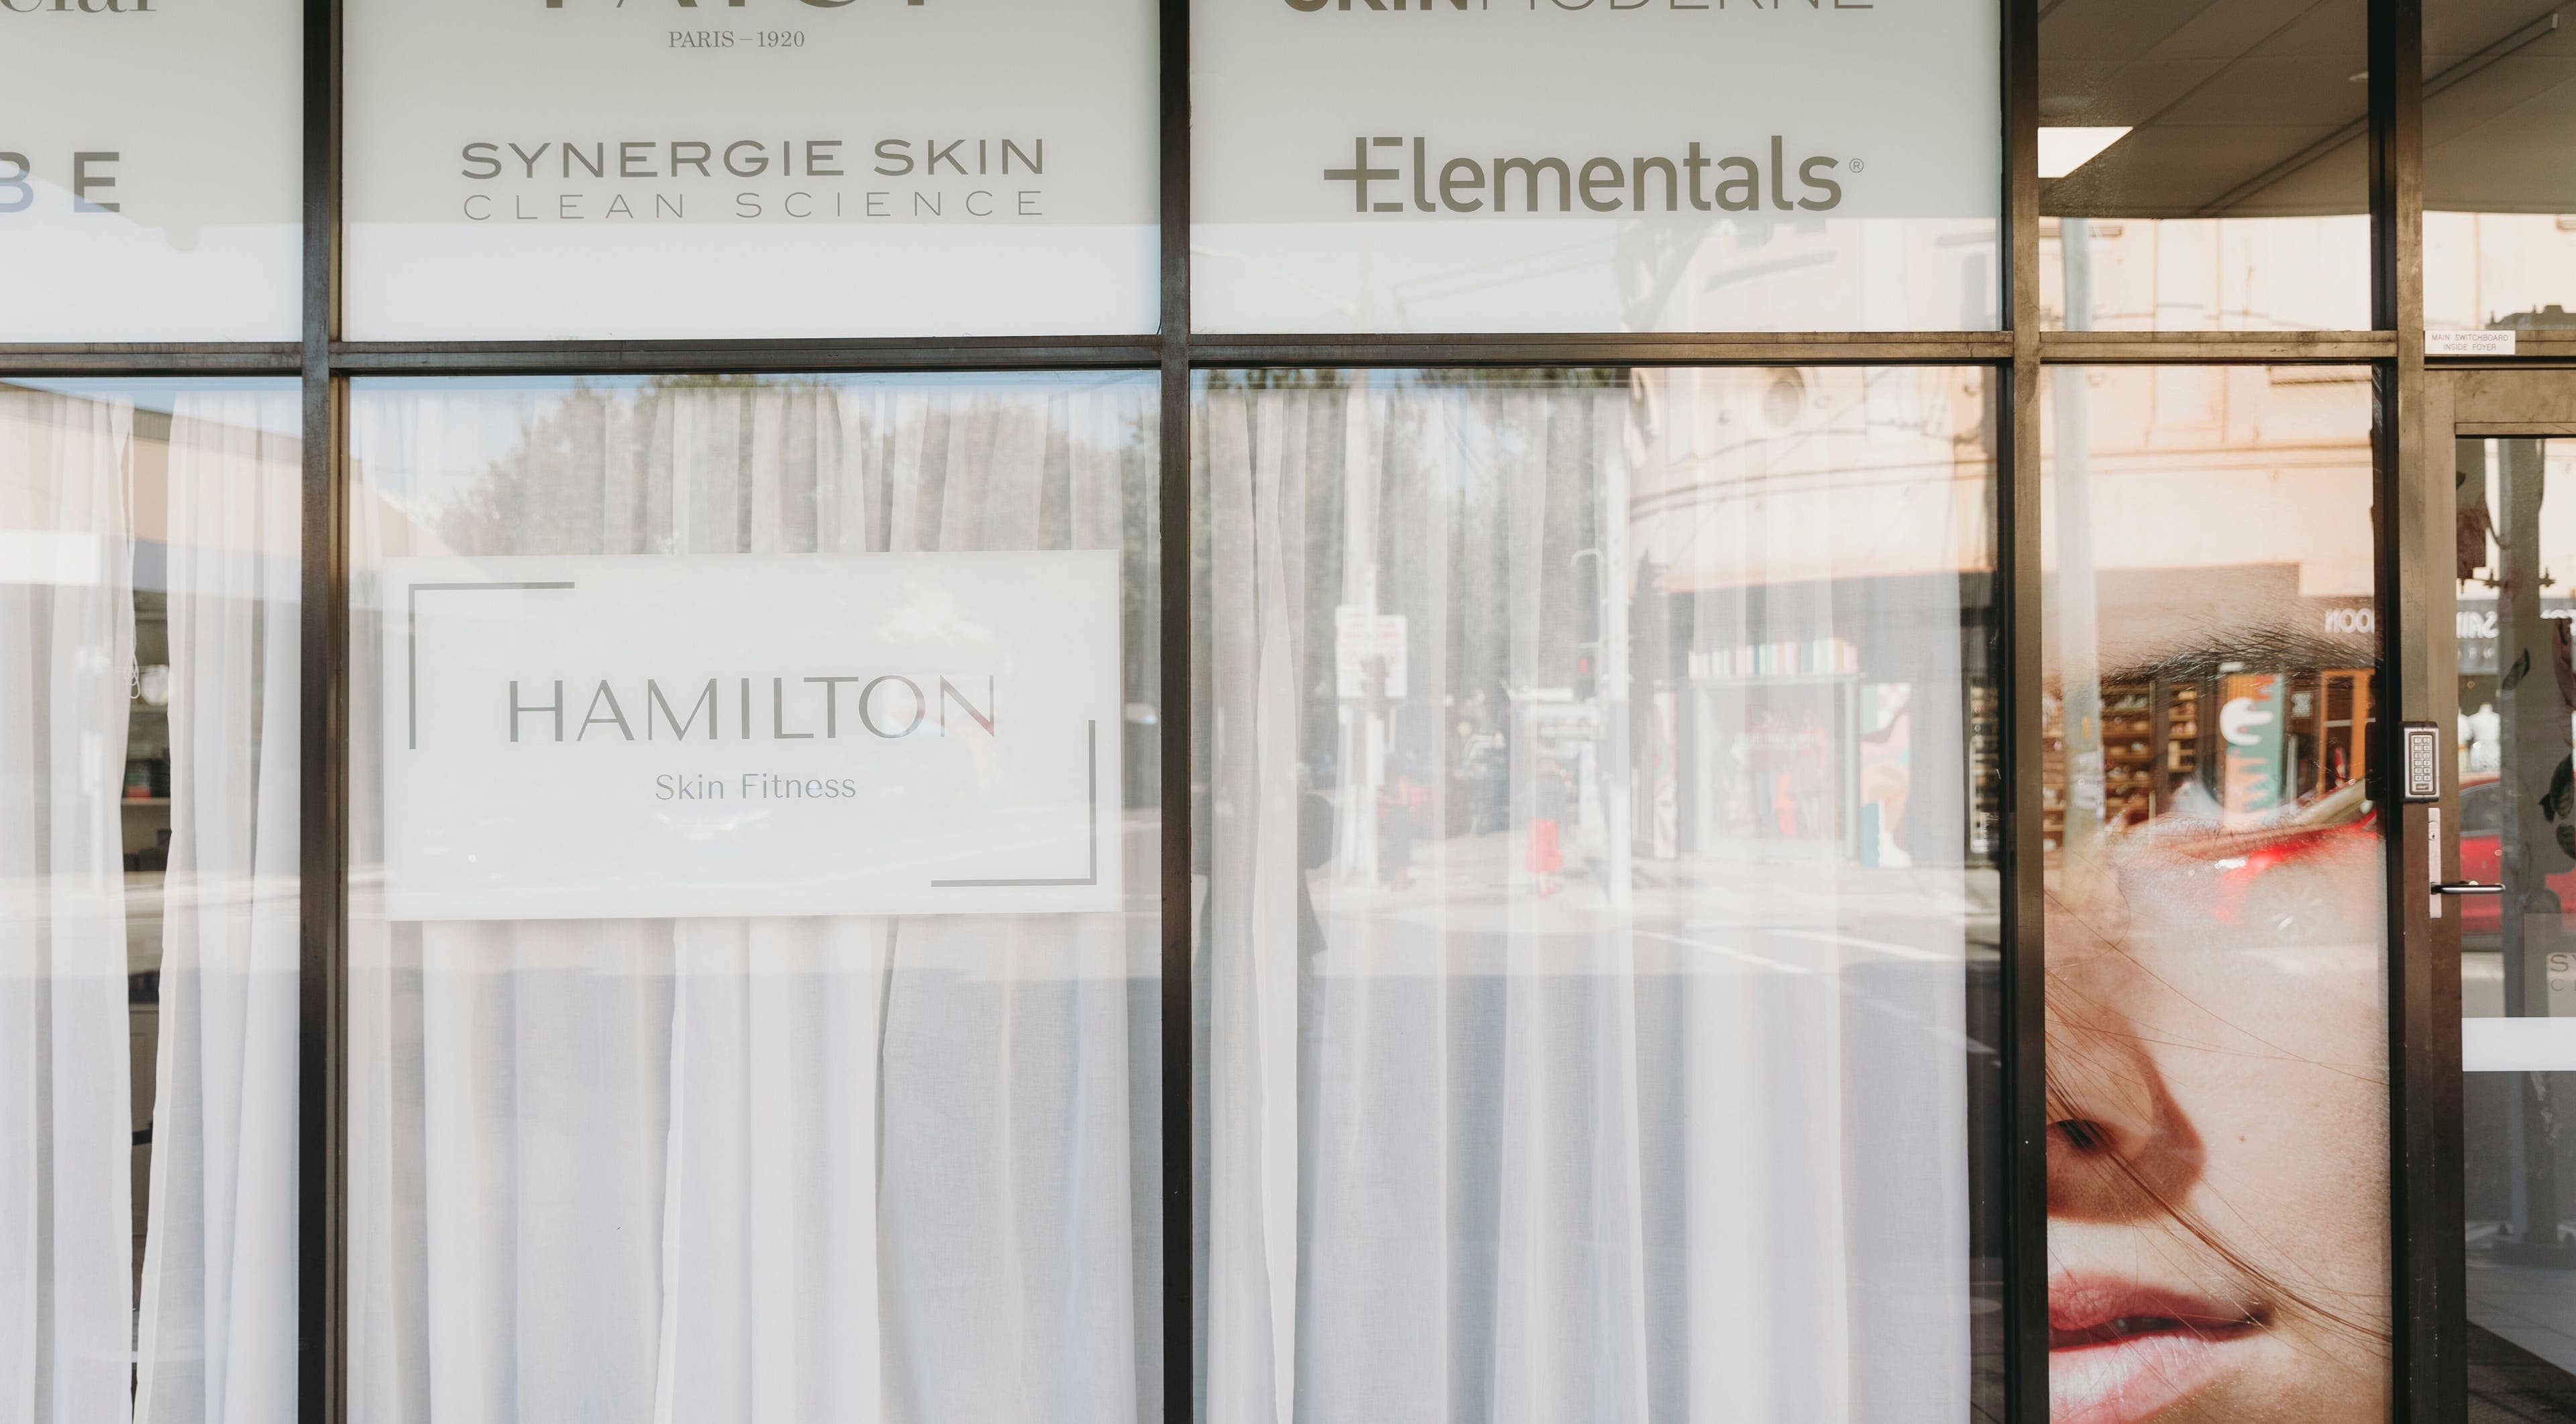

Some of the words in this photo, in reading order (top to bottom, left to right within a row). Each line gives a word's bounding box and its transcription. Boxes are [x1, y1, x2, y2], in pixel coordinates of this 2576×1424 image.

[668, 30, 735, 48] PARIS
[757, 30, 805, 48] 1920
[461, 140, 845, 180] SYNERGIE
[873, 138, 1043, 176] SKIN
[464, 193, 683, 221] CLEAN
[735, 190, 1043, 219] SCIENCE
[509, 675, 995, 743] HAMILTON
[655, 773, 724, 801] Skin
[741, 773, 856, 799] Fitness
